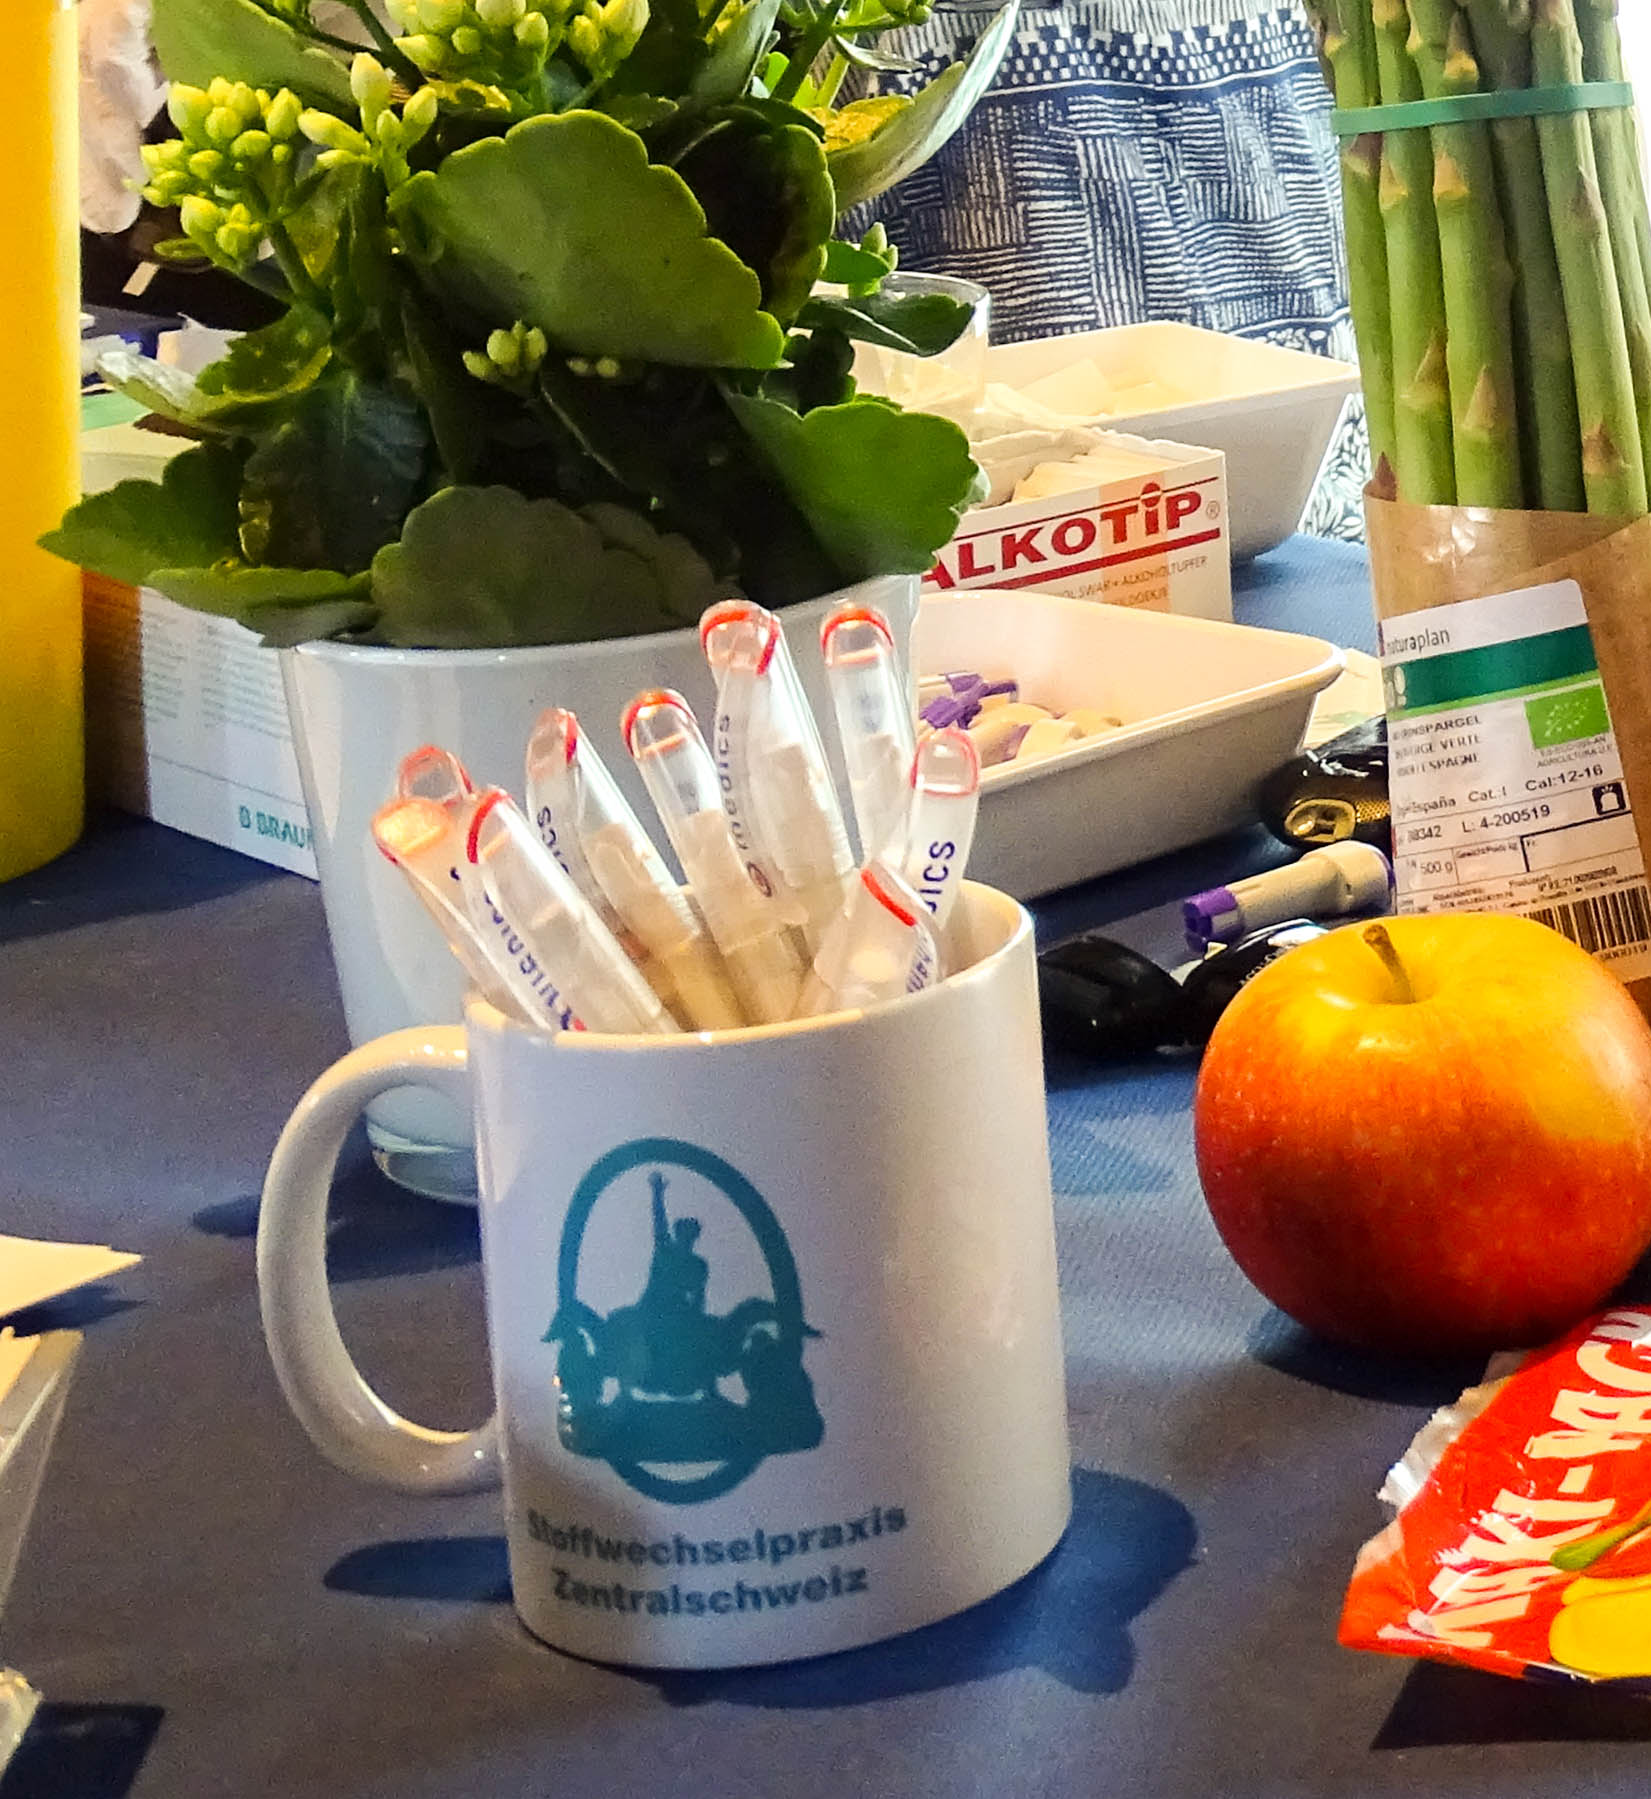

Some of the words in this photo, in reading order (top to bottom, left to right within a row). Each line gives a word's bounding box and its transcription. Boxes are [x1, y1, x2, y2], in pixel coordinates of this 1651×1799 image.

[1479, 804, 1551, 831] 4-200519
[527, 1504, 907, 1568] Stoffwechselpraxis
[551, 1564, 869, 1618] Zentralschweiz
